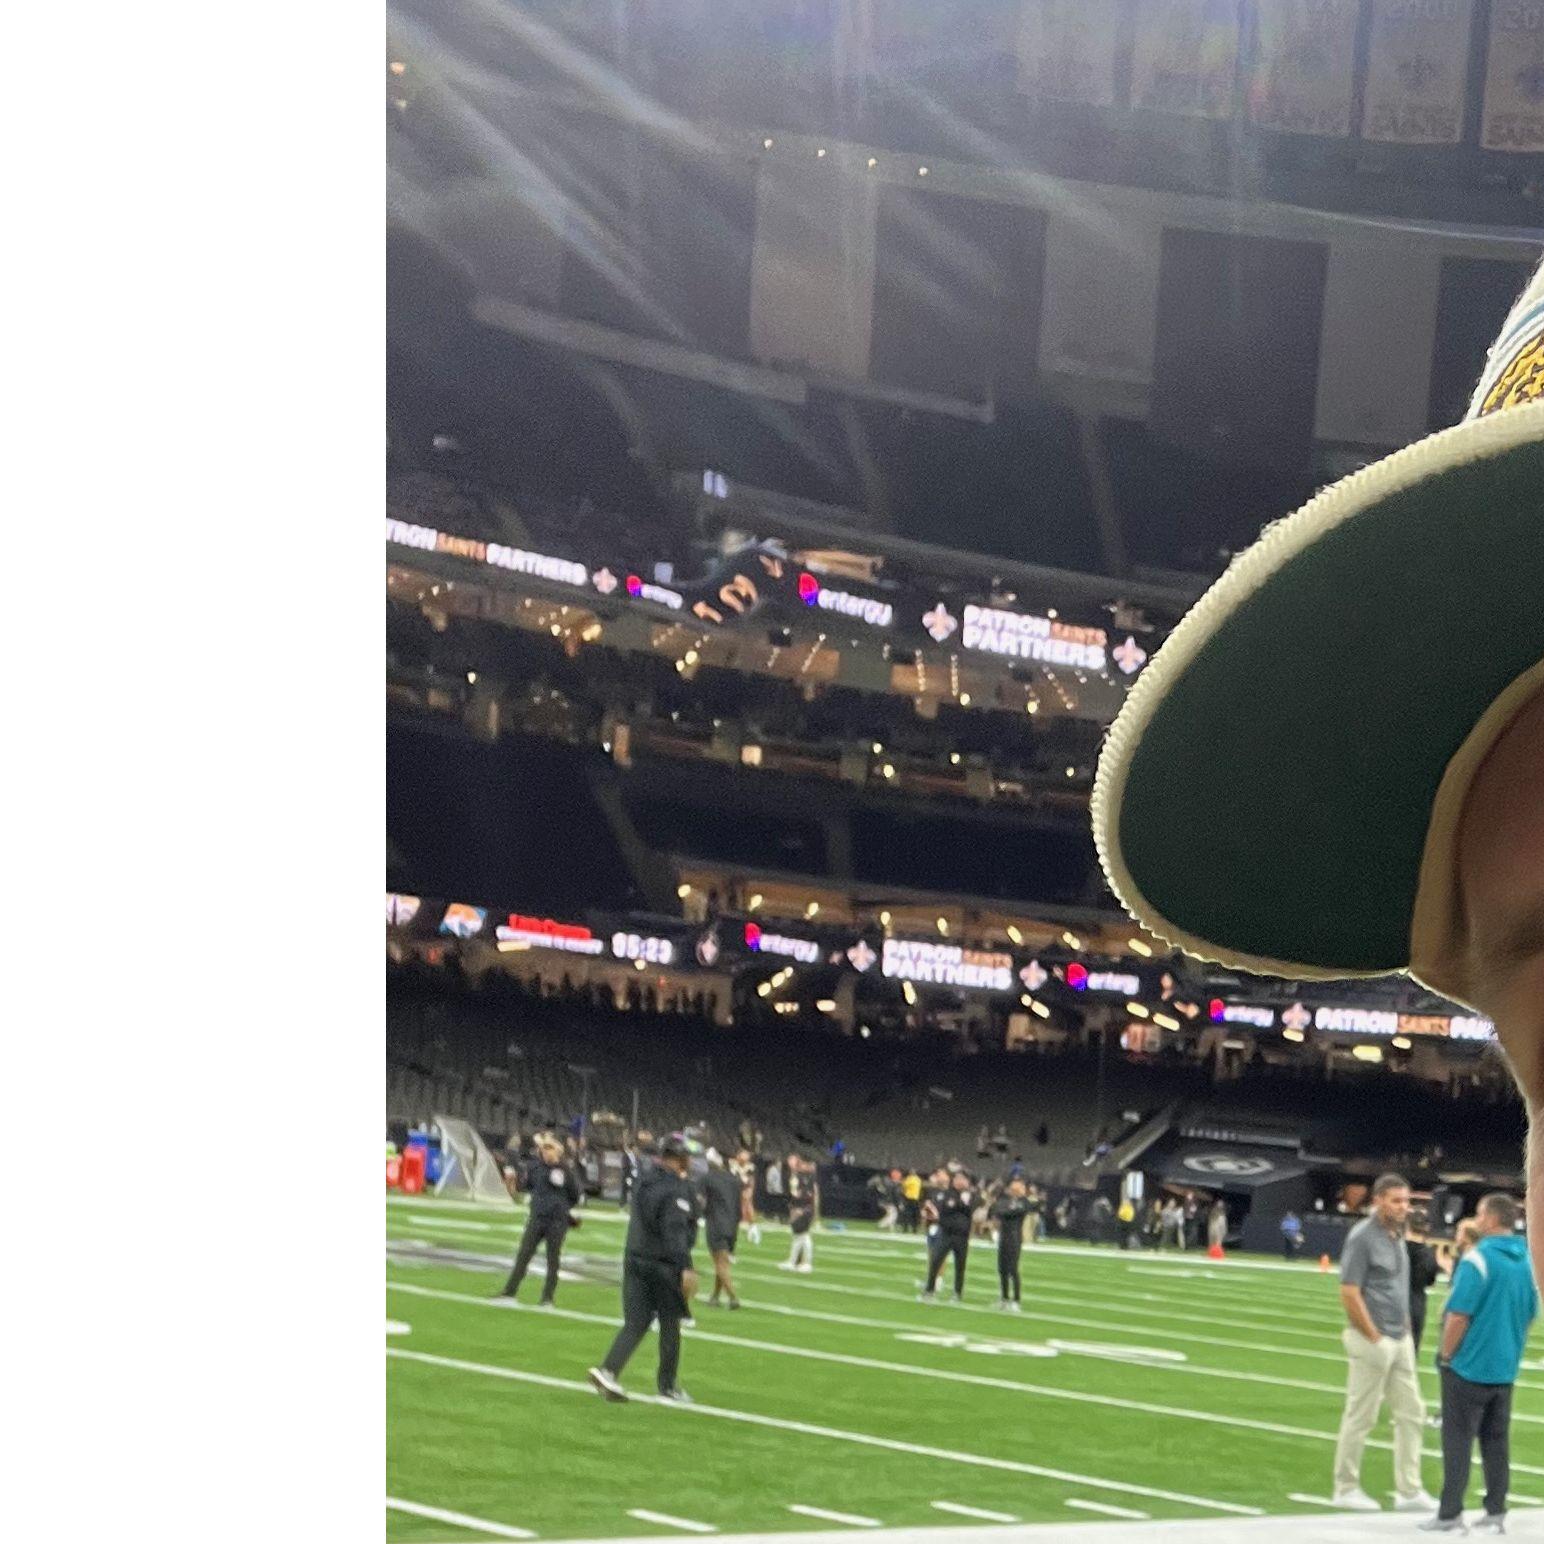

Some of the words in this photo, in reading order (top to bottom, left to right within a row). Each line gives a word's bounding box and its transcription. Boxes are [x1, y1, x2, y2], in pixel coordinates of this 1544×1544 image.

[961, 624, 1107, 671] PARTNERS
[880, 956, 1013, 991] PARTNERS
[1314, 1006, 1400, 1035] PATRON
